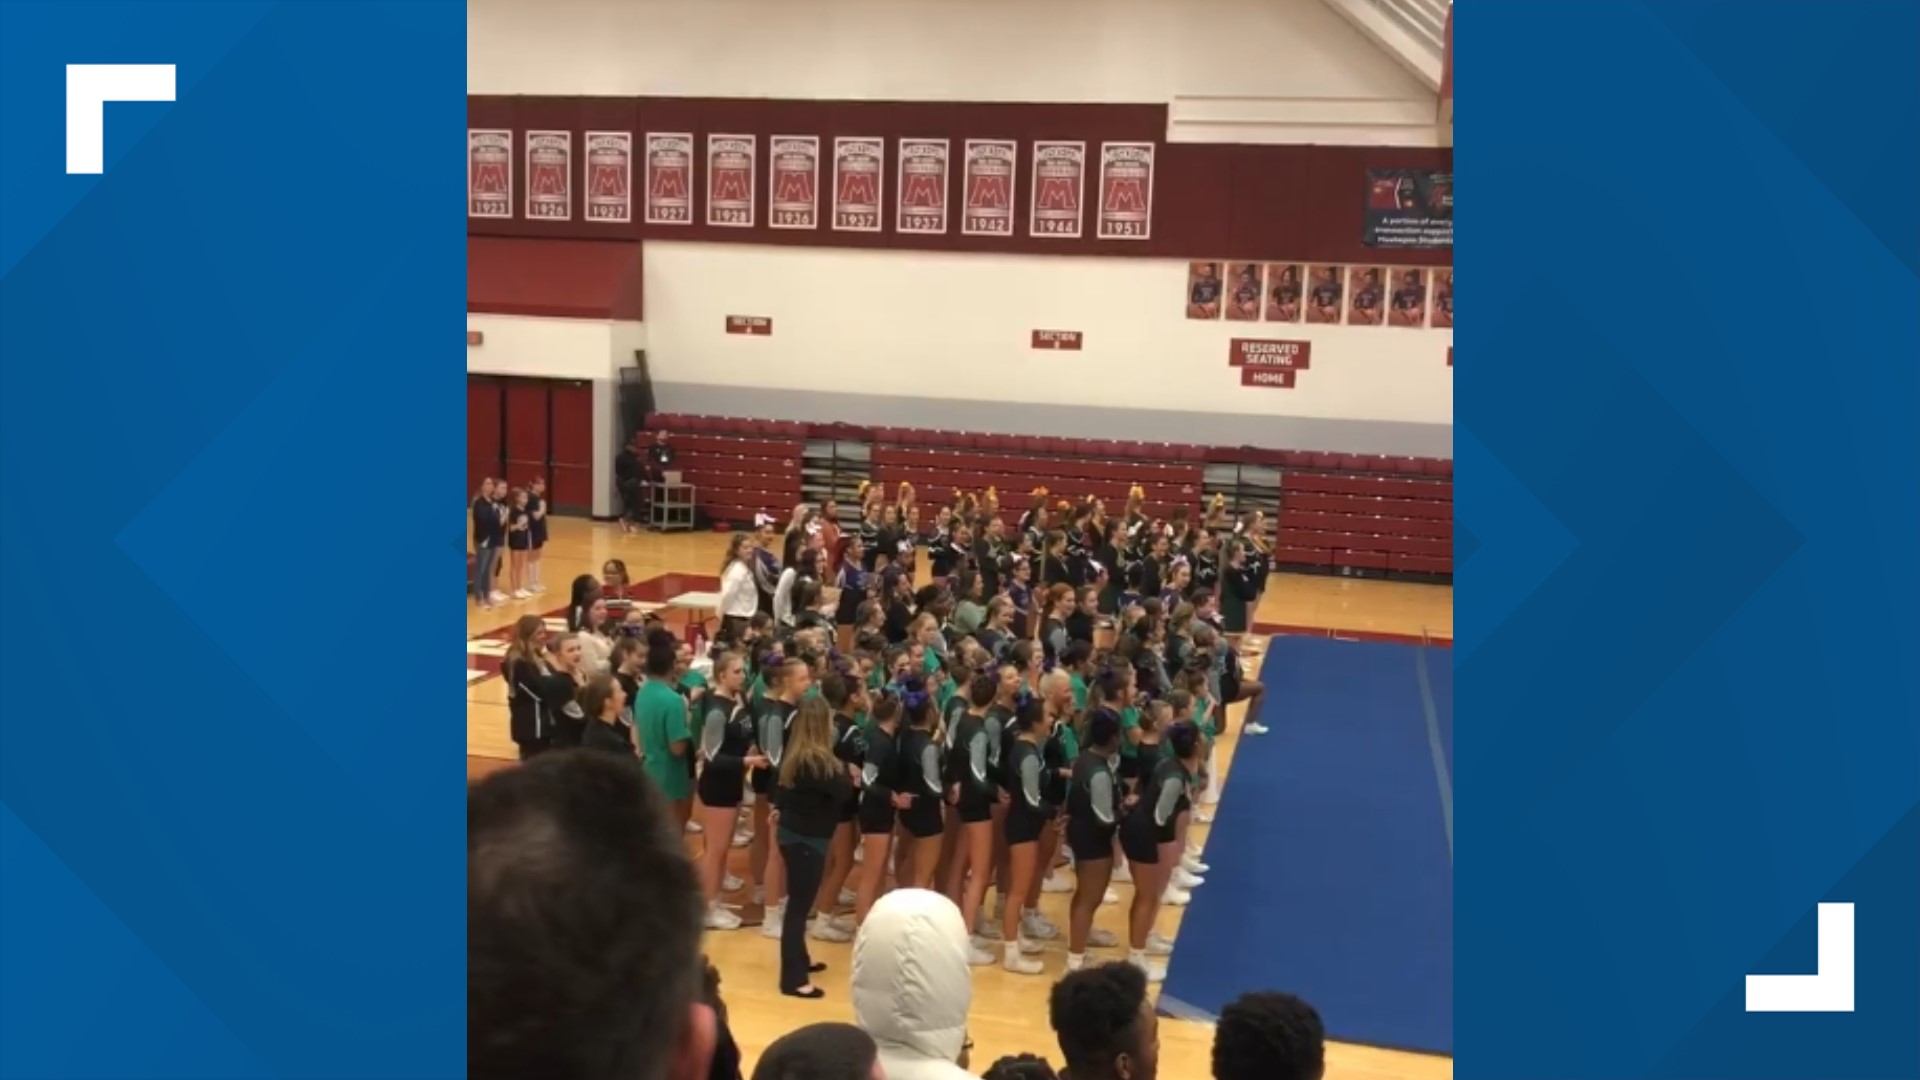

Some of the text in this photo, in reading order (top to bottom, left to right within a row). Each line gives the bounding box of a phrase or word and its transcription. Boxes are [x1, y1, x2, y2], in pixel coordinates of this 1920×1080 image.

[474, 163, 506, 192] M
[532, 165, 565, 193] M
[590, 166, 626, 195] M
[651, 167, 687, 197] M
[714, 170, 749, 199] M
[777, 171, 812, 201] M
[840, 173, 876, 203] M
[904, 174, 941, 205] M
[970, 176, 1007, 207] M
[1038, 178, 1076, 209] M
[1106, 179, 1145, 210] M
[534, 204, 564, 216] 1926
[592, 206, 623, 218] 1927
[653, 207, 684, 220] 1927
[715, 210, 747, 222] 1928
[777, 212, 810, 224] 1936
[841, 214, 874, 226] 1937
[906, 216, 938, 228] 1937
[970, 220, 1005, 231] 1942
[1039, 220, 1073, 233] 1944
[1106, 222, 1140, 234] 1951
[1241, 342, 1299, 355] RESERVED
[1246, 353, 1292, 366] SEATING
[1253, 372, 1285, 384] HOME
